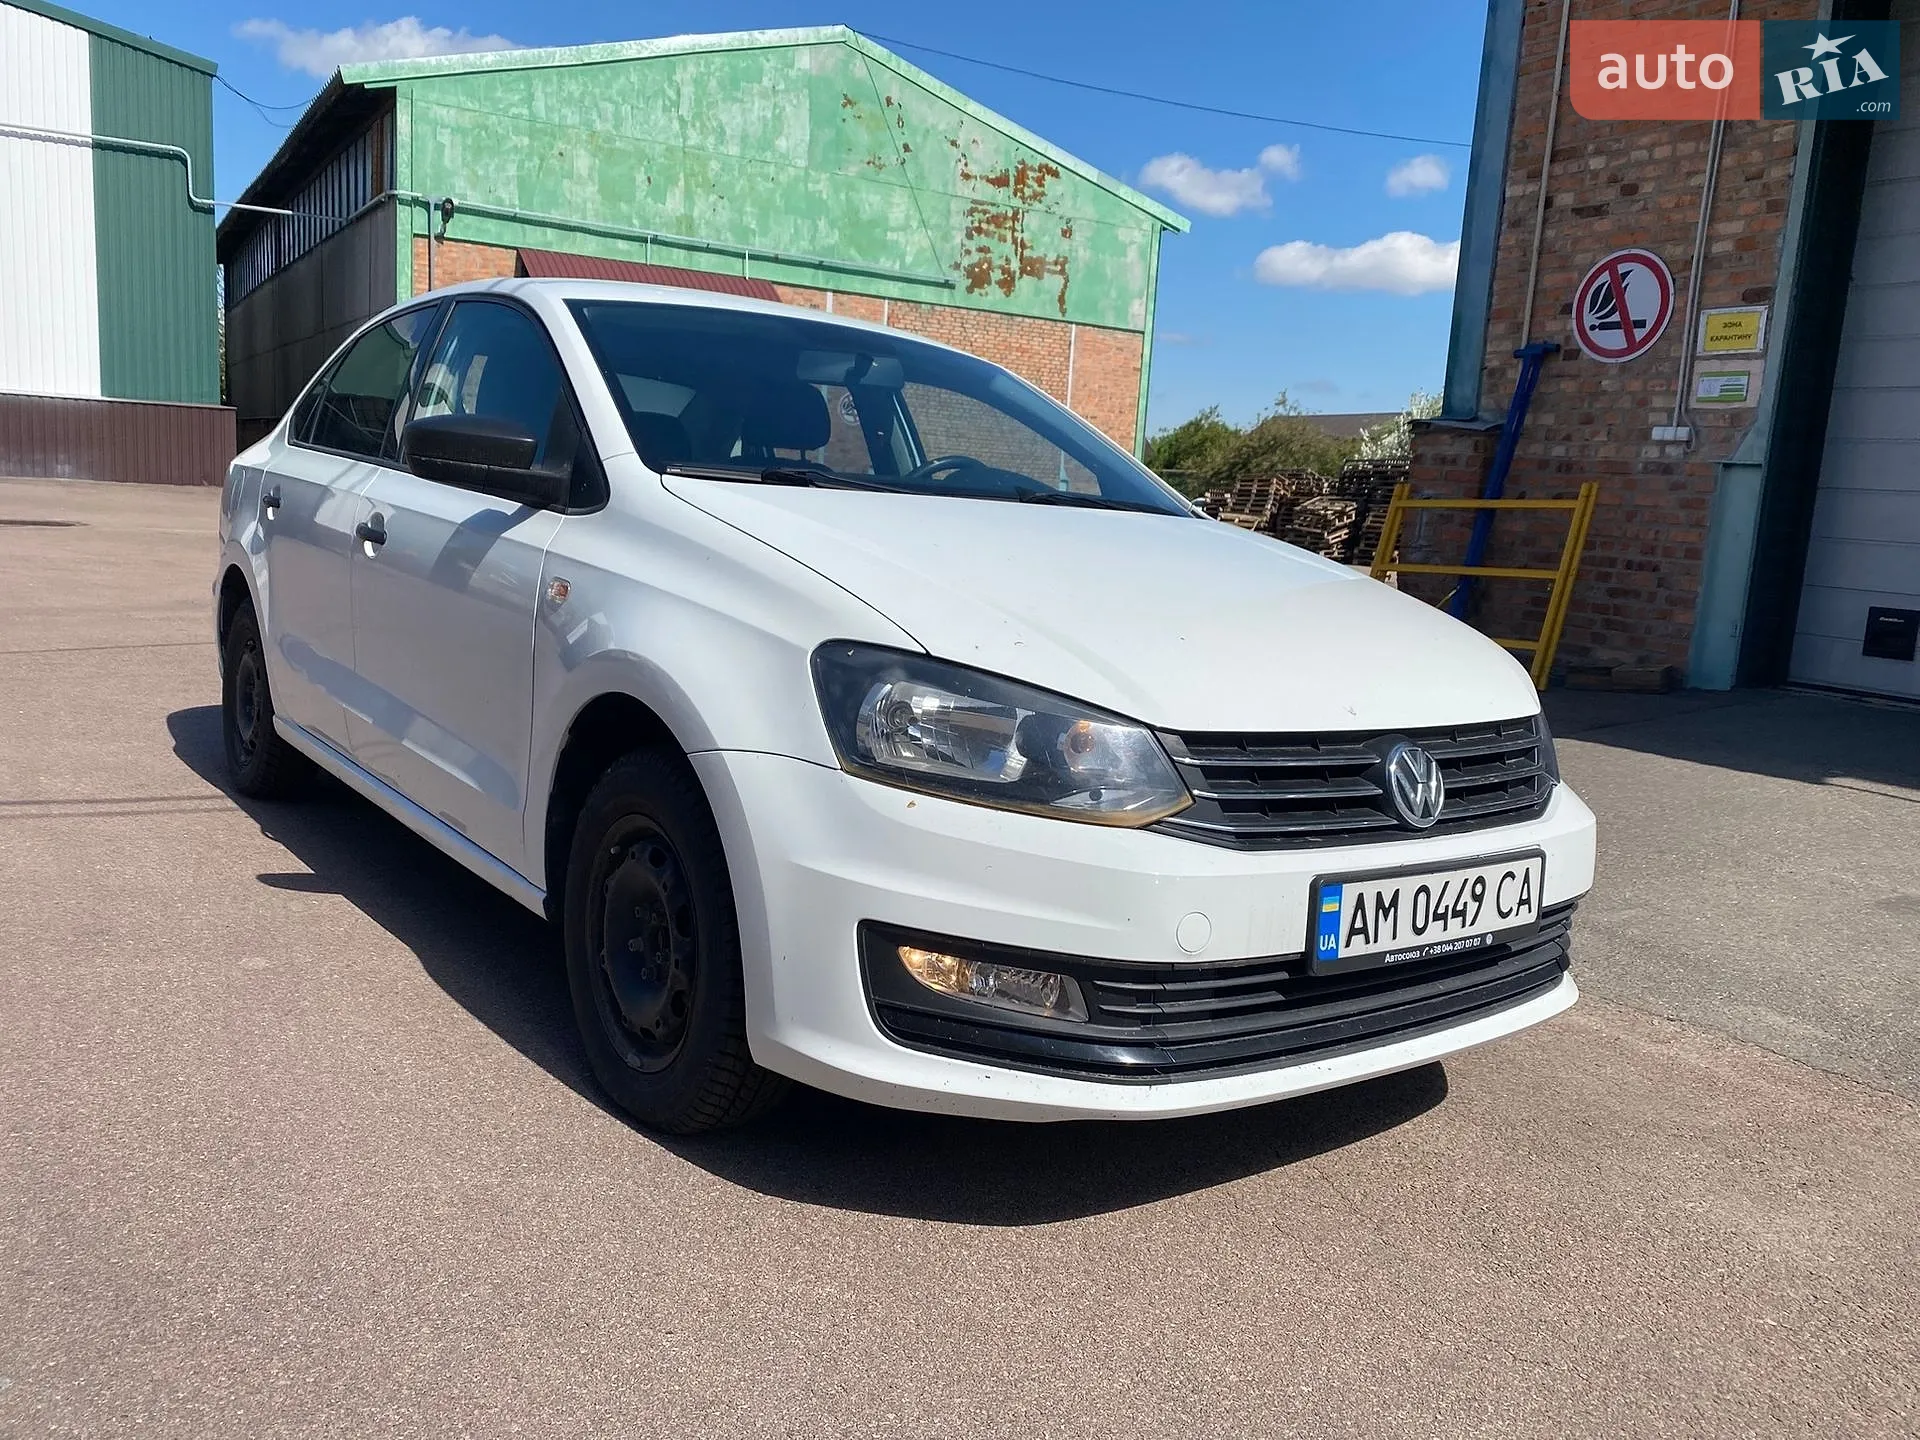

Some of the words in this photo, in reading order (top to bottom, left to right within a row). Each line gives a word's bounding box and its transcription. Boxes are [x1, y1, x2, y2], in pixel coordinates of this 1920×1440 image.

[1722, 321, 1743, 329] ЗОНА
[1710, 333, 1753, 342] КАРАНТИНУ
[1344, 888, 1400, 949] AM
[1411, 875, 1487, 936] 0449
[1496, 867, 1532, 919] CA
[1320, 933, 1337, 951] UA
[1454, 941, 1465, 950] 207
[1466, 939, 1473, 948] 07
[1474, 938, 1481, 946] 07
